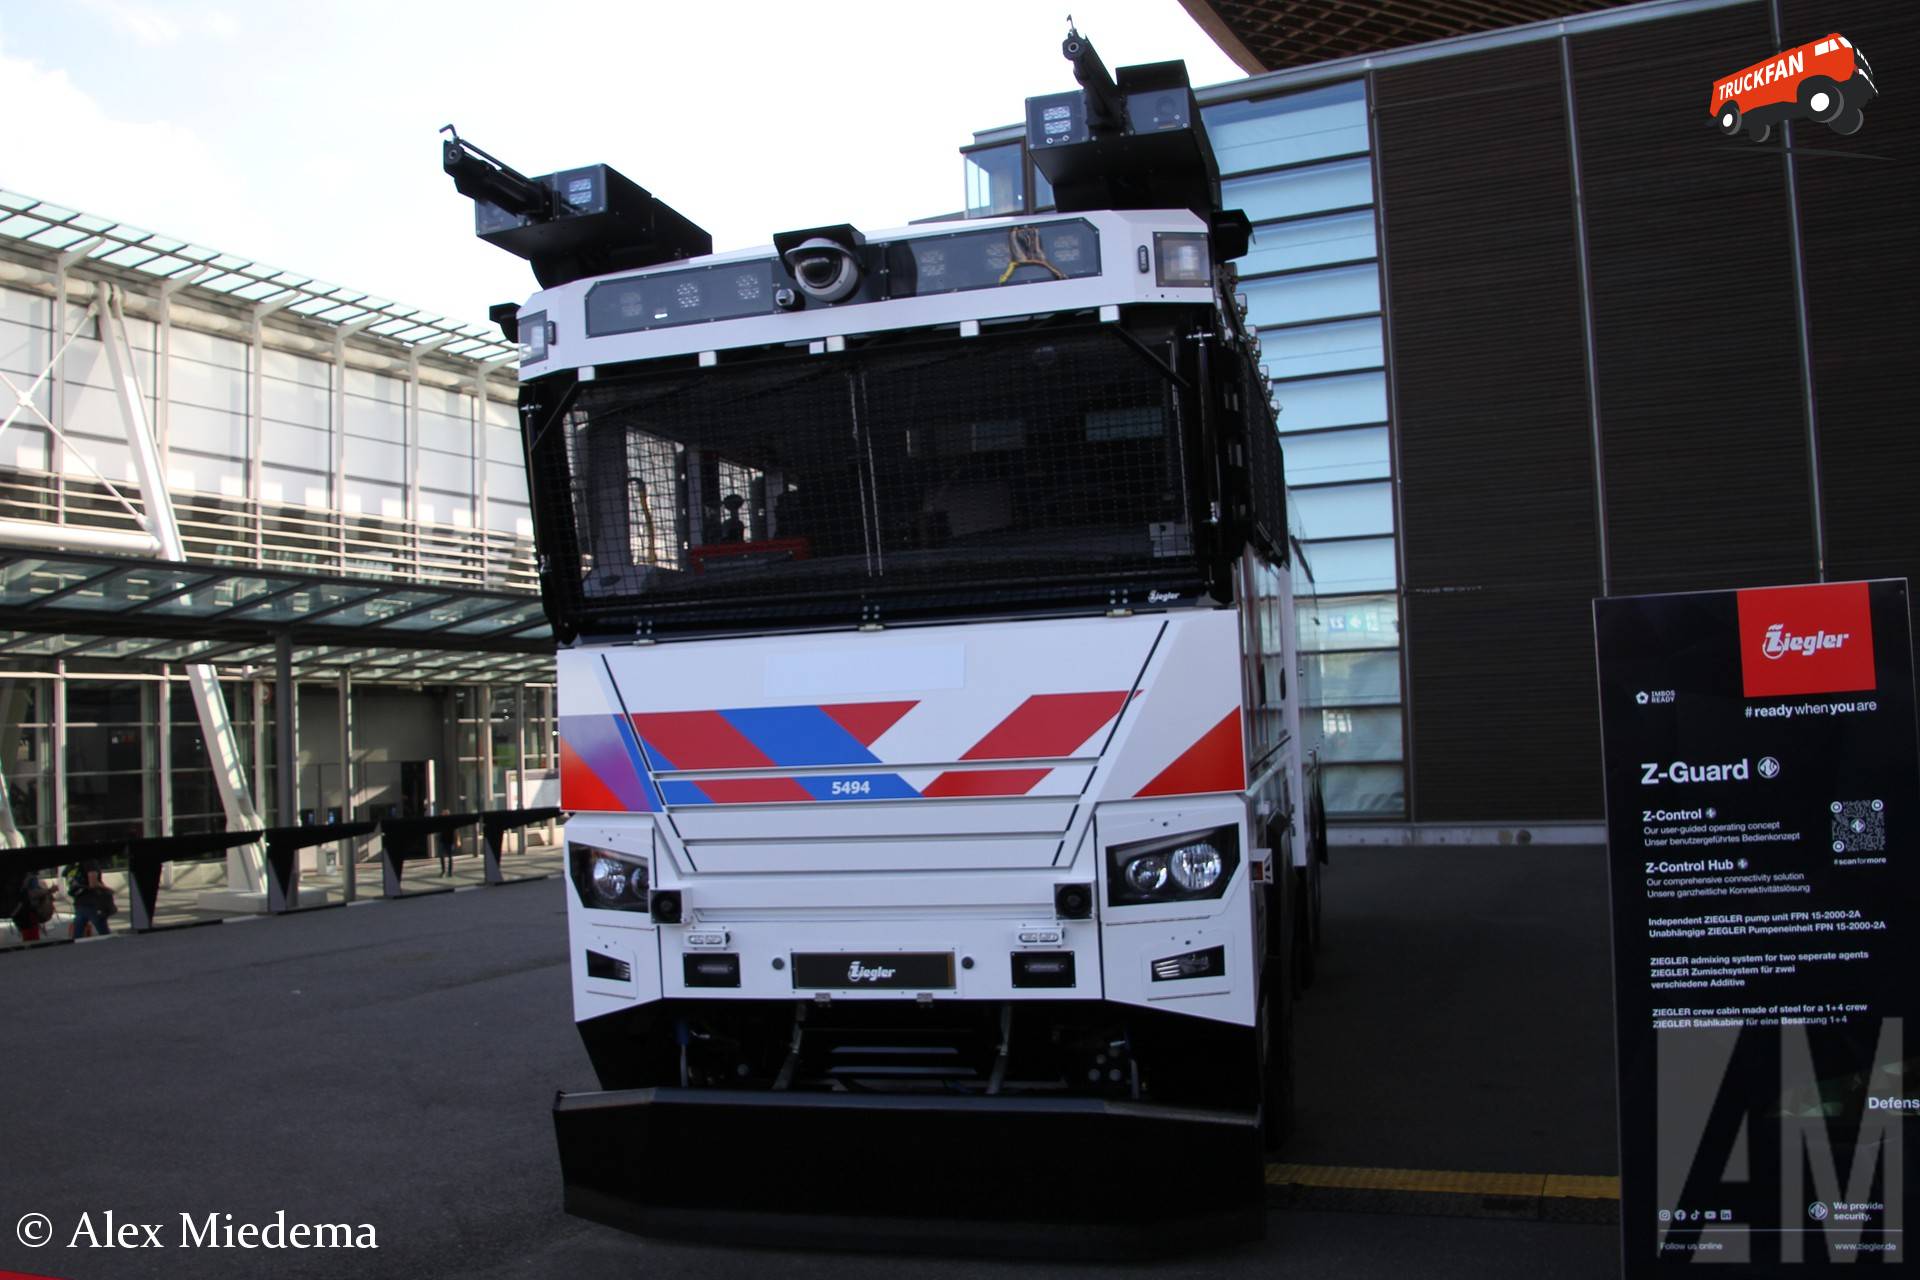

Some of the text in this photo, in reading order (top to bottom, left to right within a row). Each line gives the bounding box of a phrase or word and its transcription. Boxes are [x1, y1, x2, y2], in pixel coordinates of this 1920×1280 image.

[1762, 624, 1849, 660] Ziegler
[1641, 759, 1748, 784] Z-Guard
[831, 780, 870, 794] 5494
[1642, 808, 1702, 822] Z-Control
[1644, 820, 1780, 834] Our user-guided operating concept
[1644, 832, 1800, 846] Unser benutzergeführtes Bedienkonzept
[1646, 860, 1734, 874] Z-Control Hub
[1647, 872, 1804, 886] Our comprehensive connectivity solution
[1648, 884, 1810, 898] Unsere ganzheitliche Konnektivitätslösung
[1649, 910, 1860, 926] Independent ZIEGLER pump unit FPN 15-2000-2A
[1649, 922, 1886, 938] Unabhängige ZIEGLER Pumpeneinheit FPN 15-2000-2A
[1650, 951, 1868, 966] ZIEGLER admixing system for two seperate agents
[848, 961, 896, 982] Ziegler
[1650, 964, 1795, 977] ZIEGLER Zumischsystem für zwei
[1651, 978, 1744, 988] verschiedene Additive
[1652, 1008, 1691, 1016] ZIEGLER
[1716, 1006, 1740, 1014] cabin
[1742, 1005, 1766, 1014] made
[1769, 1004, 1778, 1012] of
[1780, 1004, 1800, 1012] steel
[1803, 1003, 1815, 1012] for
[1826, 1003, 1844, 1012] 1+4
[1652, 1015, 1848, 1028] ZIEGLER Stahlkabine für eine Besatzung 1+4
[1833, 1202, 1884, 1212] We provide
[1834, 1212, 1872, 1222] security.
[1660, 1242, 1686, 1250] Follow
[1699, 1242, 1723, 1250] online
[1834, 1242, 1896, 1252] www.ziegler.de
